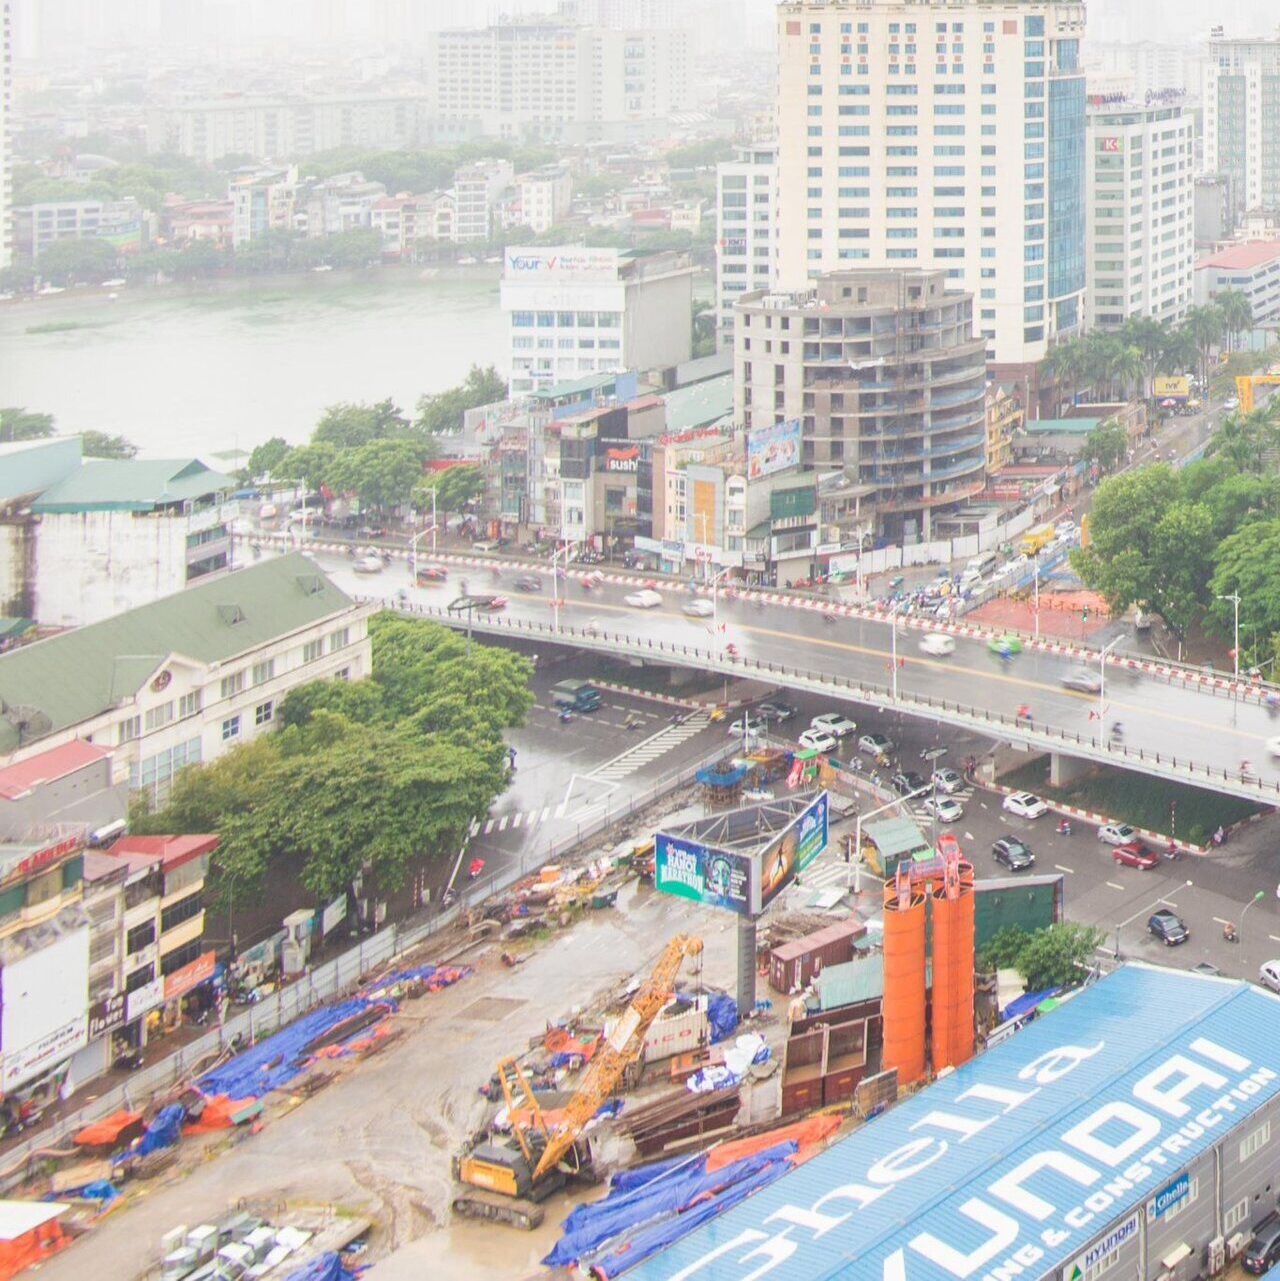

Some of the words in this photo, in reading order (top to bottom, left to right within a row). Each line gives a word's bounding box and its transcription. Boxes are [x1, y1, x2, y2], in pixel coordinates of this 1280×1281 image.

[660, 863, 704, 895] MARATHON
[1040, 1227, 1072, 1249] &
[1063, 1067, 1278, 1229] CONSTRUCTION
[1157, 1181, 1189, 1209] Ghella
[1084, 1218, 1137, 1268] HYUNDAI
